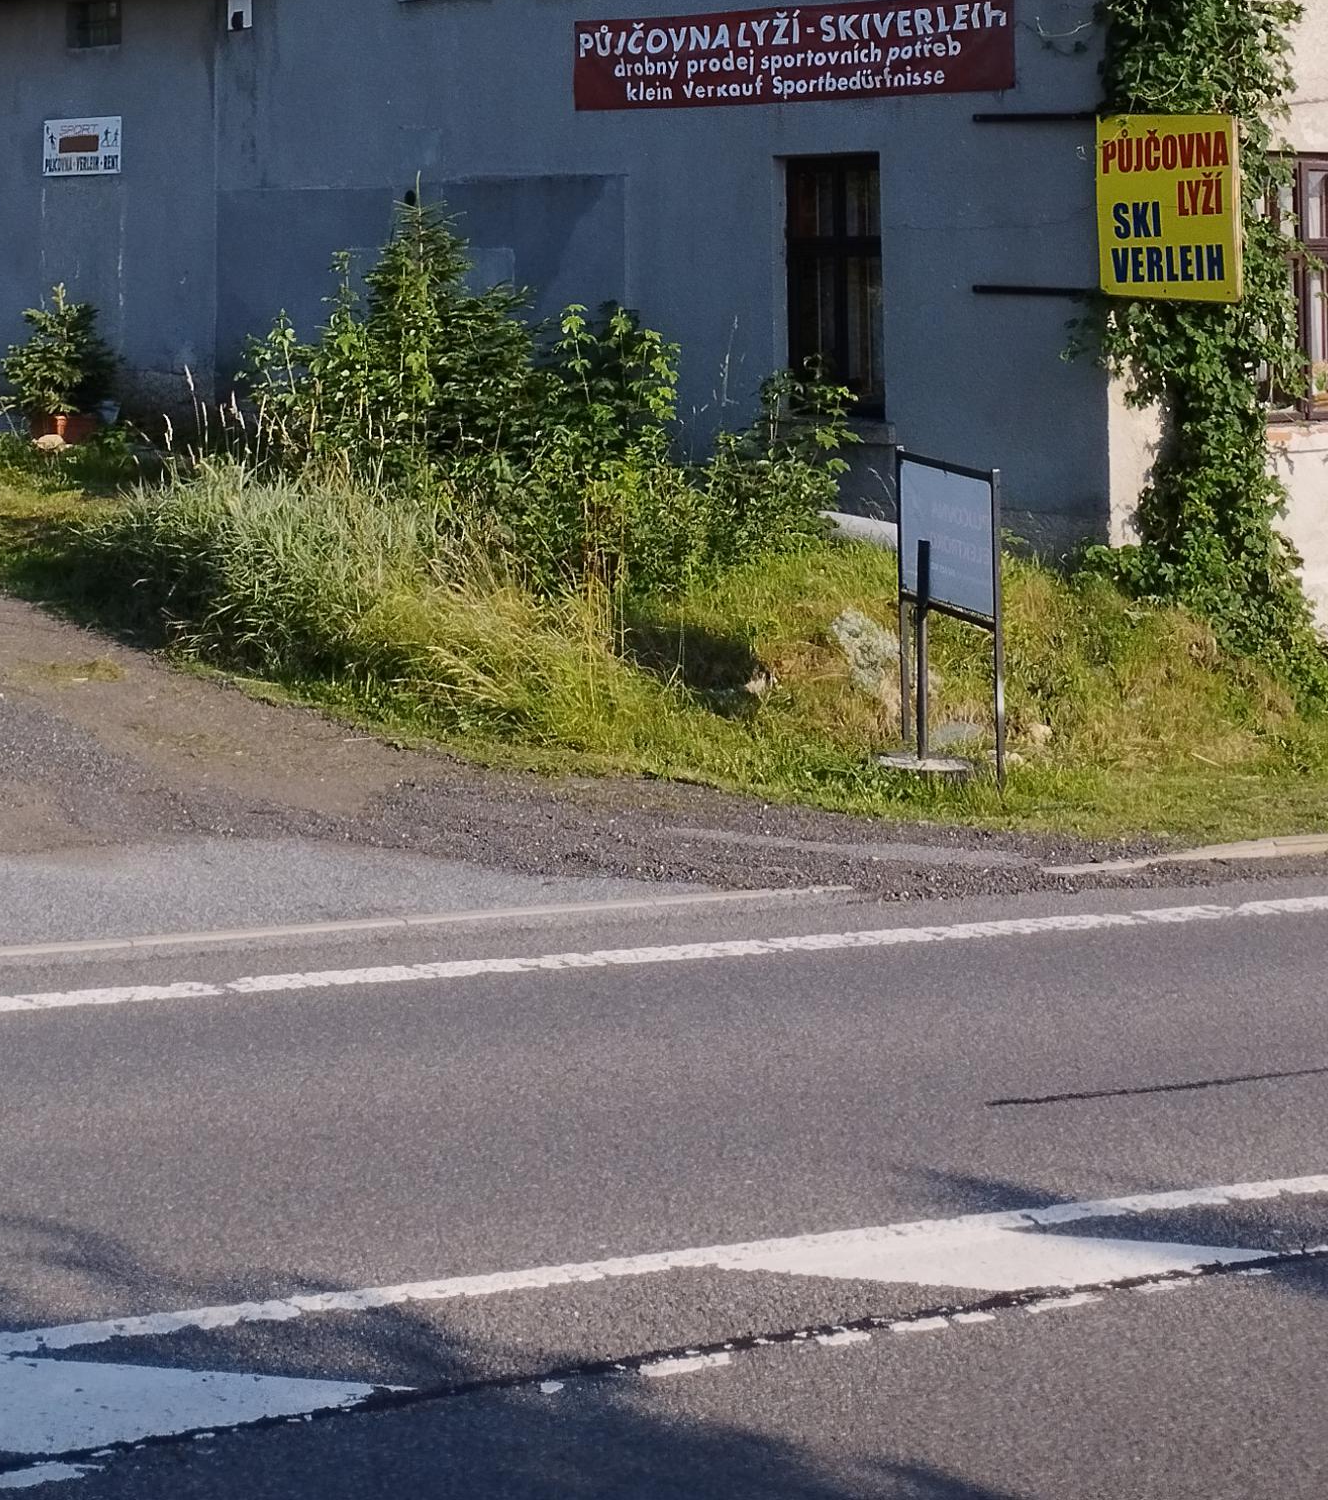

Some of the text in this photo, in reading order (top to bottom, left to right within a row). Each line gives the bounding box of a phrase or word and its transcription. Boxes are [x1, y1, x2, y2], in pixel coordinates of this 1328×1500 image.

[579, 21, 730, 58] PŮJČOVNA
[737, 9, 801, 47] LYŽÍ
[614, 34, 961, 79] drobný prodej sportovních potřeb
[626, 67, 945, 101] klein Verkauf Sportbedürfnisse
[59, 124, 98, 135] SPORT
[1102, 129, 1230, 174] PŮJČOVNA
[1177, 172, 1223, 216] LYŽÍ
[1113, 201, 1162, 239] SKI
[1111, 244, 1225, 283] VERLEIH
